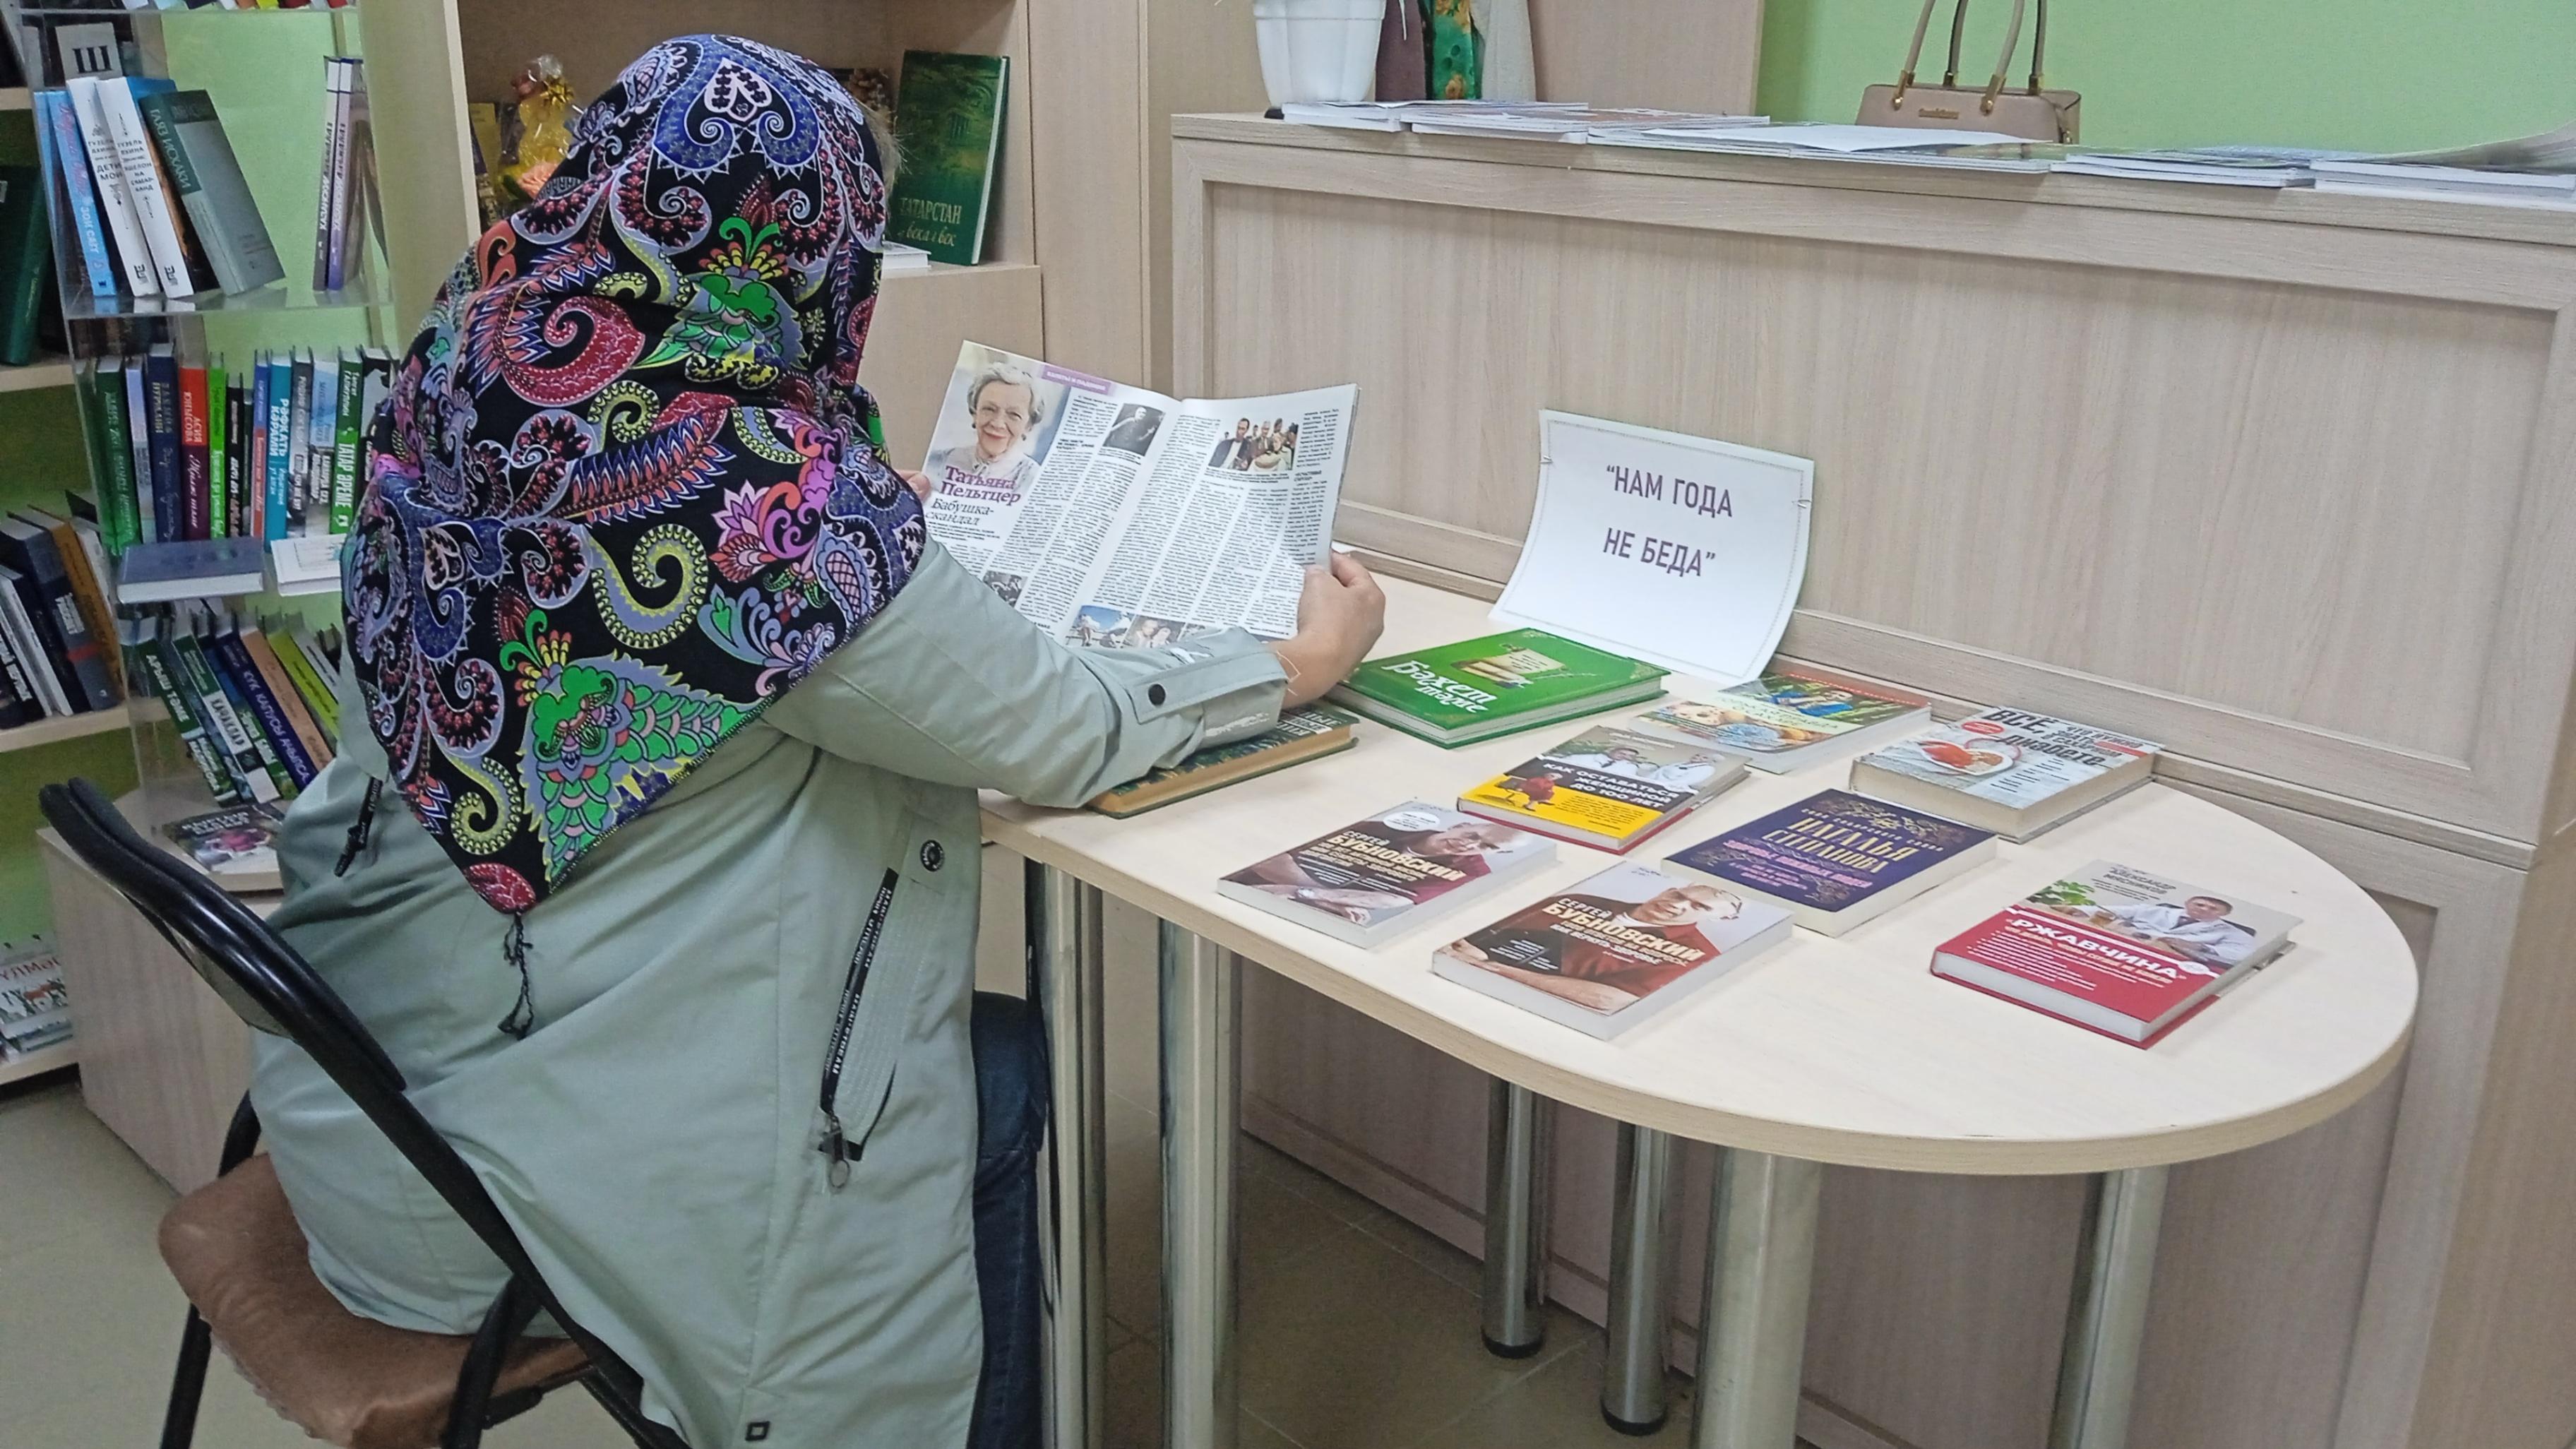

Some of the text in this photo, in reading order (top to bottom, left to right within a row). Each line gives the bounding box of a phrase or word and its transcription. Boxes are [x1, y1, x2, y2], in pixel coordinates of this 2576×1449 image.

[73, 45, 112, 73] Ш
[150, 109, 168, 136] ГАЯЗ
[97, 162, 121, 173] ДЕТИ
[100, 171, 122, 181] МОИ
[900, 198, 962, 225] ТАТАРСТАН
[193, 417, 203, 443] АСИЯ
[337, 443, 355, 471] ТАТАР
[945, 465, 1015, 490] Татьяна
[939, 481, 1021, 506] Пельтцер
[1606, 465, 1732, 519] “НАМ ГОДА
[925, 511, 980, 525] скандал
[931, 498, 994, 515] Бабушка-
[1603, 527, 1716, 577] НЕ БЕДА”
[146, 655, 172, 690] АРЫШ
[1541, 763, 1681, 798] КАК ОСТАВАТЬСЯ
[1571, 776, 1674, 804] ЖЕНЩИНОЙ
[1567, 782, 1666, 808] ДО 100 ЛЕТ
[1341, 830, 1392, 847] СЕРГЕЙ
[1758, 829, 1895, 873] СТЕПАНОВА
[1783, 817, 1922, 861] НАТАЛЬЯ
[1324, 834, 1469, 881] БУБНОВСКИЙ
[1555, 898, 1614, 919] СЕРГЕЙ
[1539, 902, 1707, 962] БУБНОВСКИЙ
